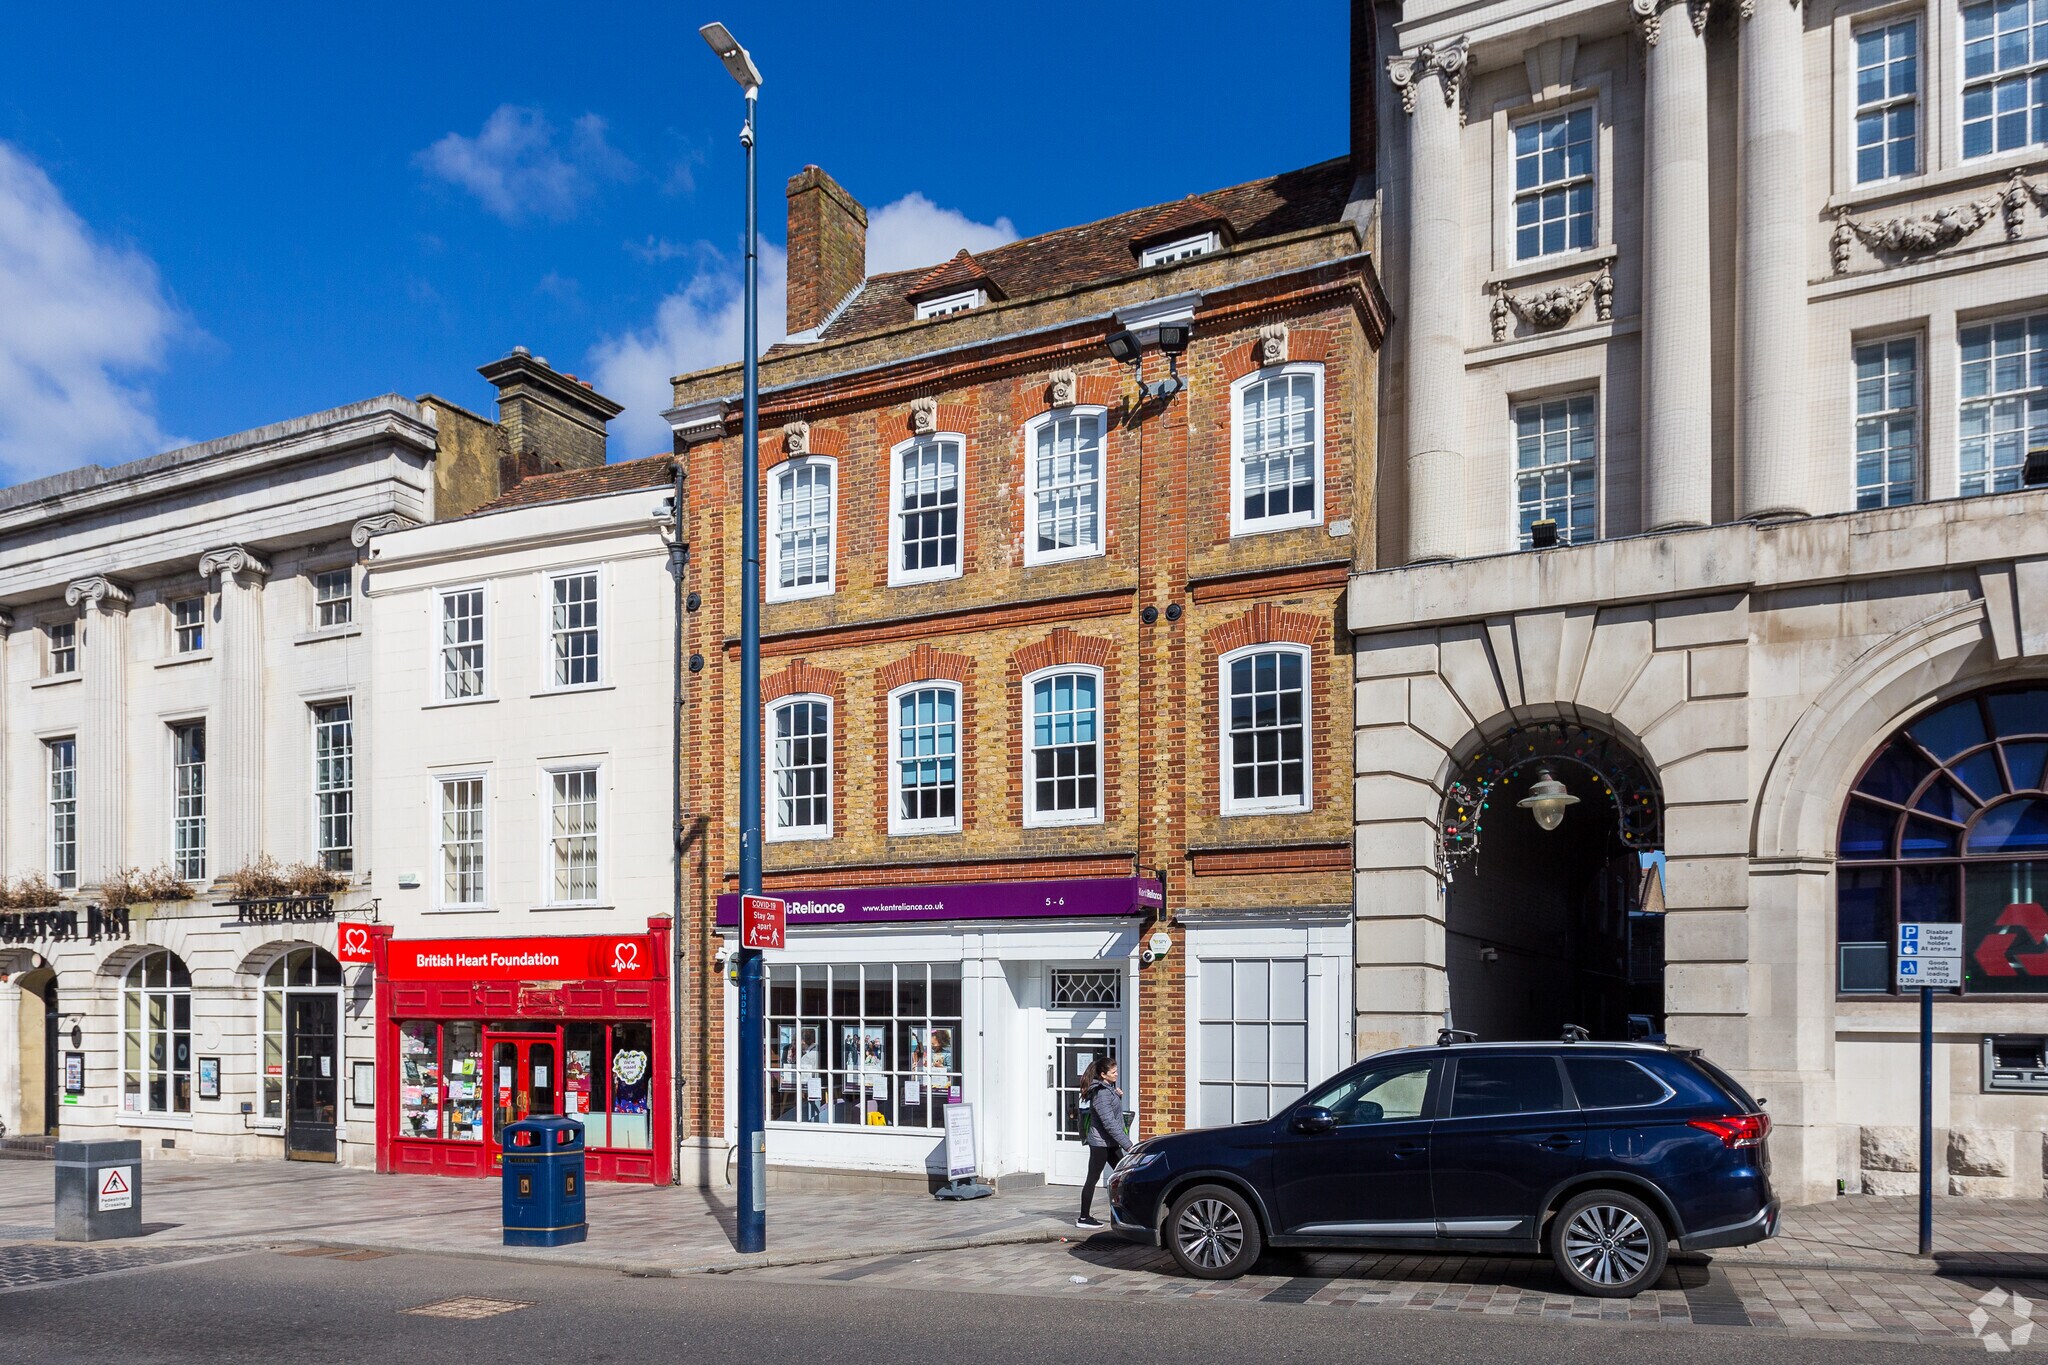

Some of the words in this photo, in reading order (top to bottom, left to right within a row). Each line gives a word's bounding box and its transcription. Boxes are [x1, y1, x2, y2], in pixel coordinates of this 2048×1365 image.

[752, 900, 776, 909] COVID-19
[1046, 898, 1051, 906] 5
[239, 902, 279, 922] FREE
[282, 899, 334, 920] HOUSE
[862, 902, 944, 912] www.kentreliance.co.uk
[754, 911, 765, 920] Stay
[757, 922, 772, 930] apart
[416, 954, 453, 967] British
[456, 954, 488, 966] Heart
[491, 952, 559, 966] Foundation
